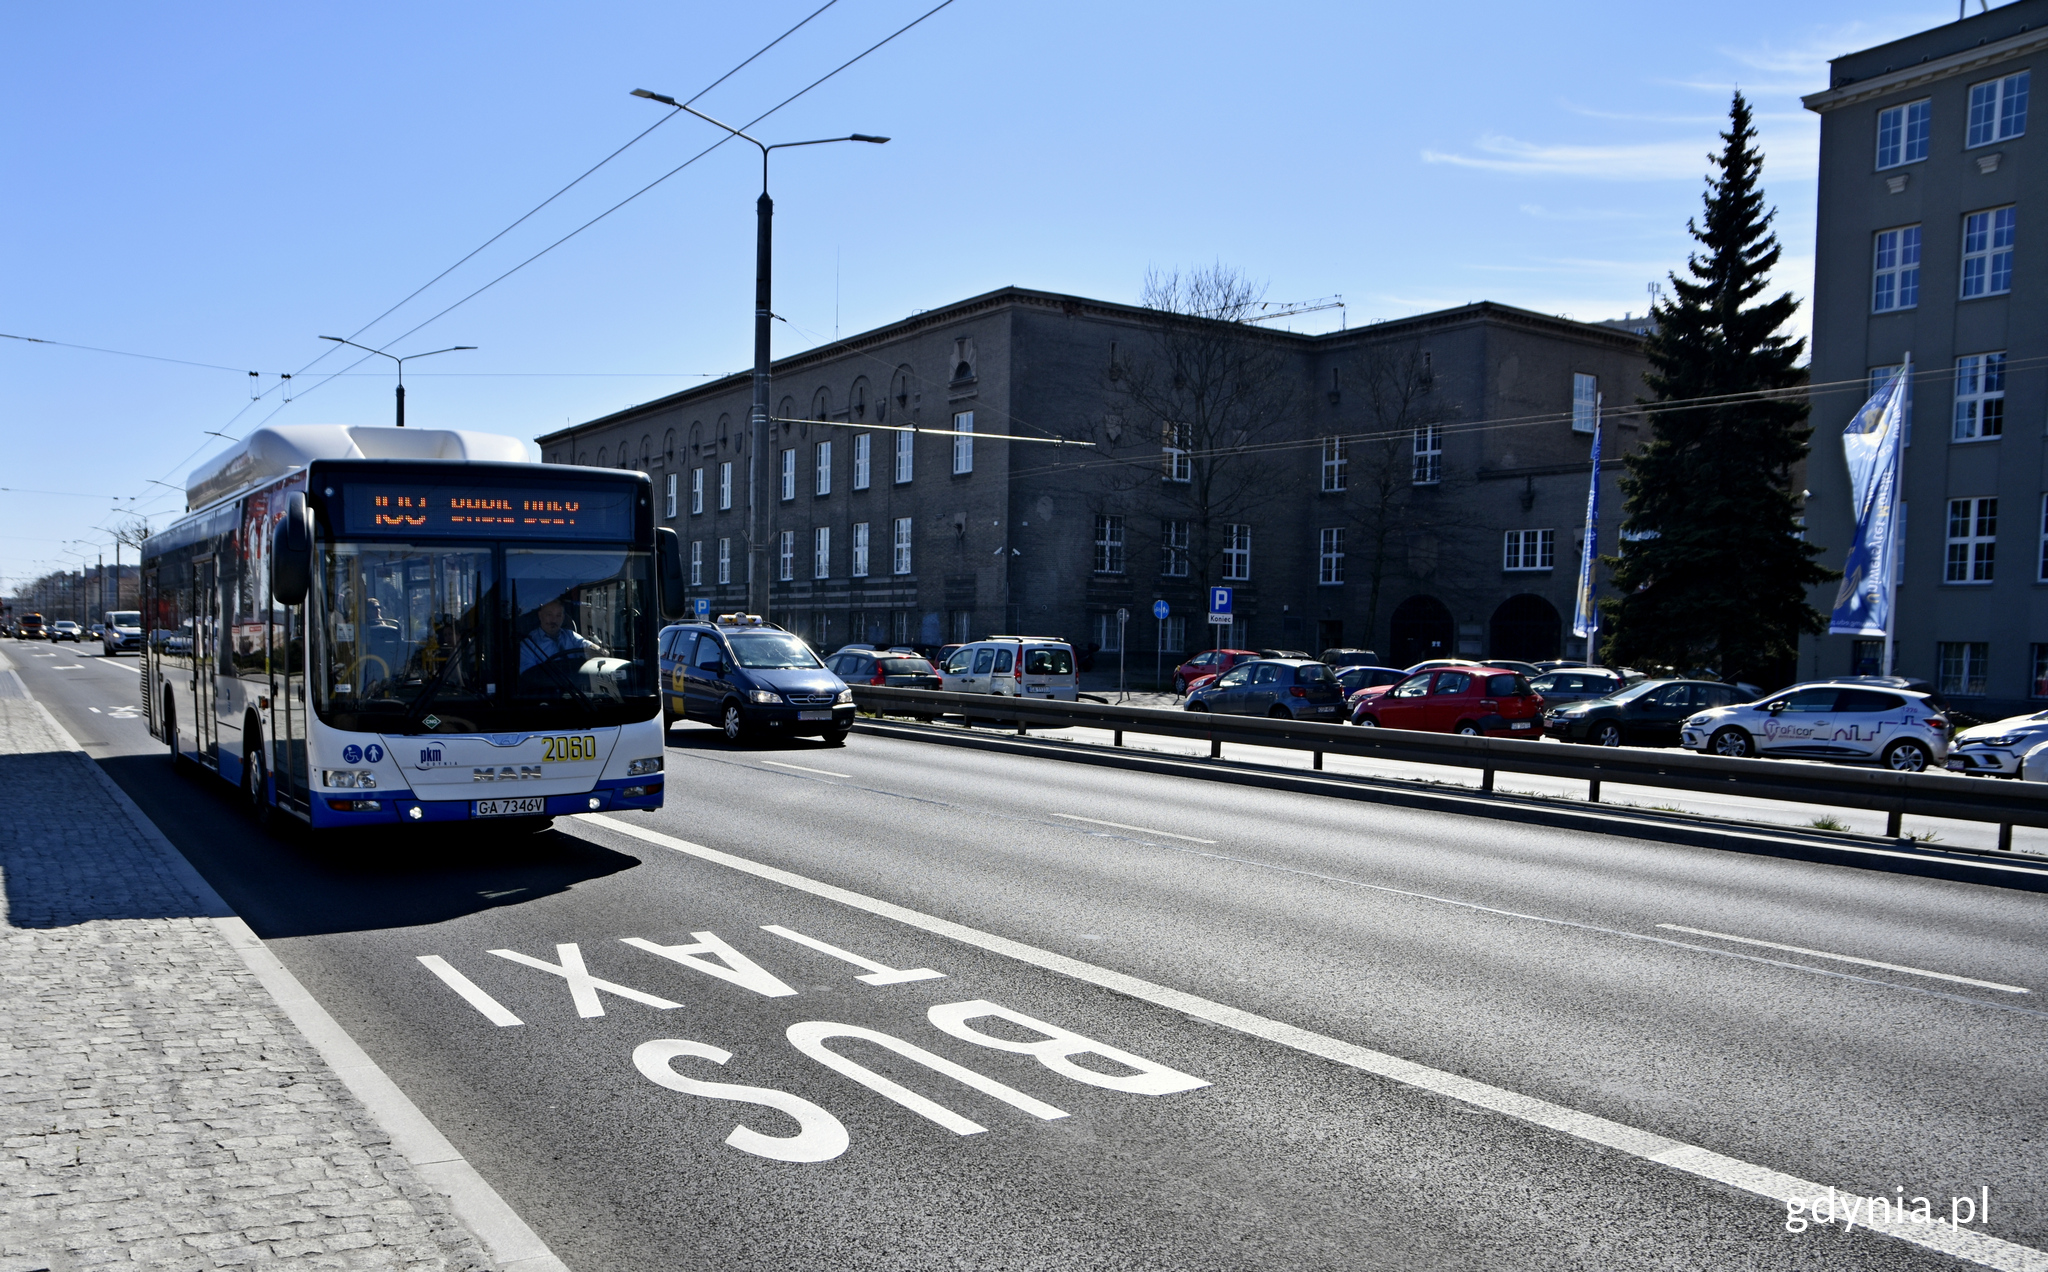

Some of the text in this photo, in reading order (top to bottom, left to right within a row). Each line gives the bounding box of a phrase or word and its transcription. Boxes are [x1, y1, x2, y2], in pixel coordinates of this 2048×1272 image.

[1215, 590, 1228, 610] P
[1210, 615, 1231, 623] Koniec
[1768, 723, 1815, 736] Traficar
[420, 747, 442, 764] pkm
[541, 735, 596, 762] 2060
[473, 765, 542, 782] MAN
[479, 798, 543, 815] GA 7346V
[416, 925, 947, 1027] TAXI
[632, 999, 1213, 1163] BUS
